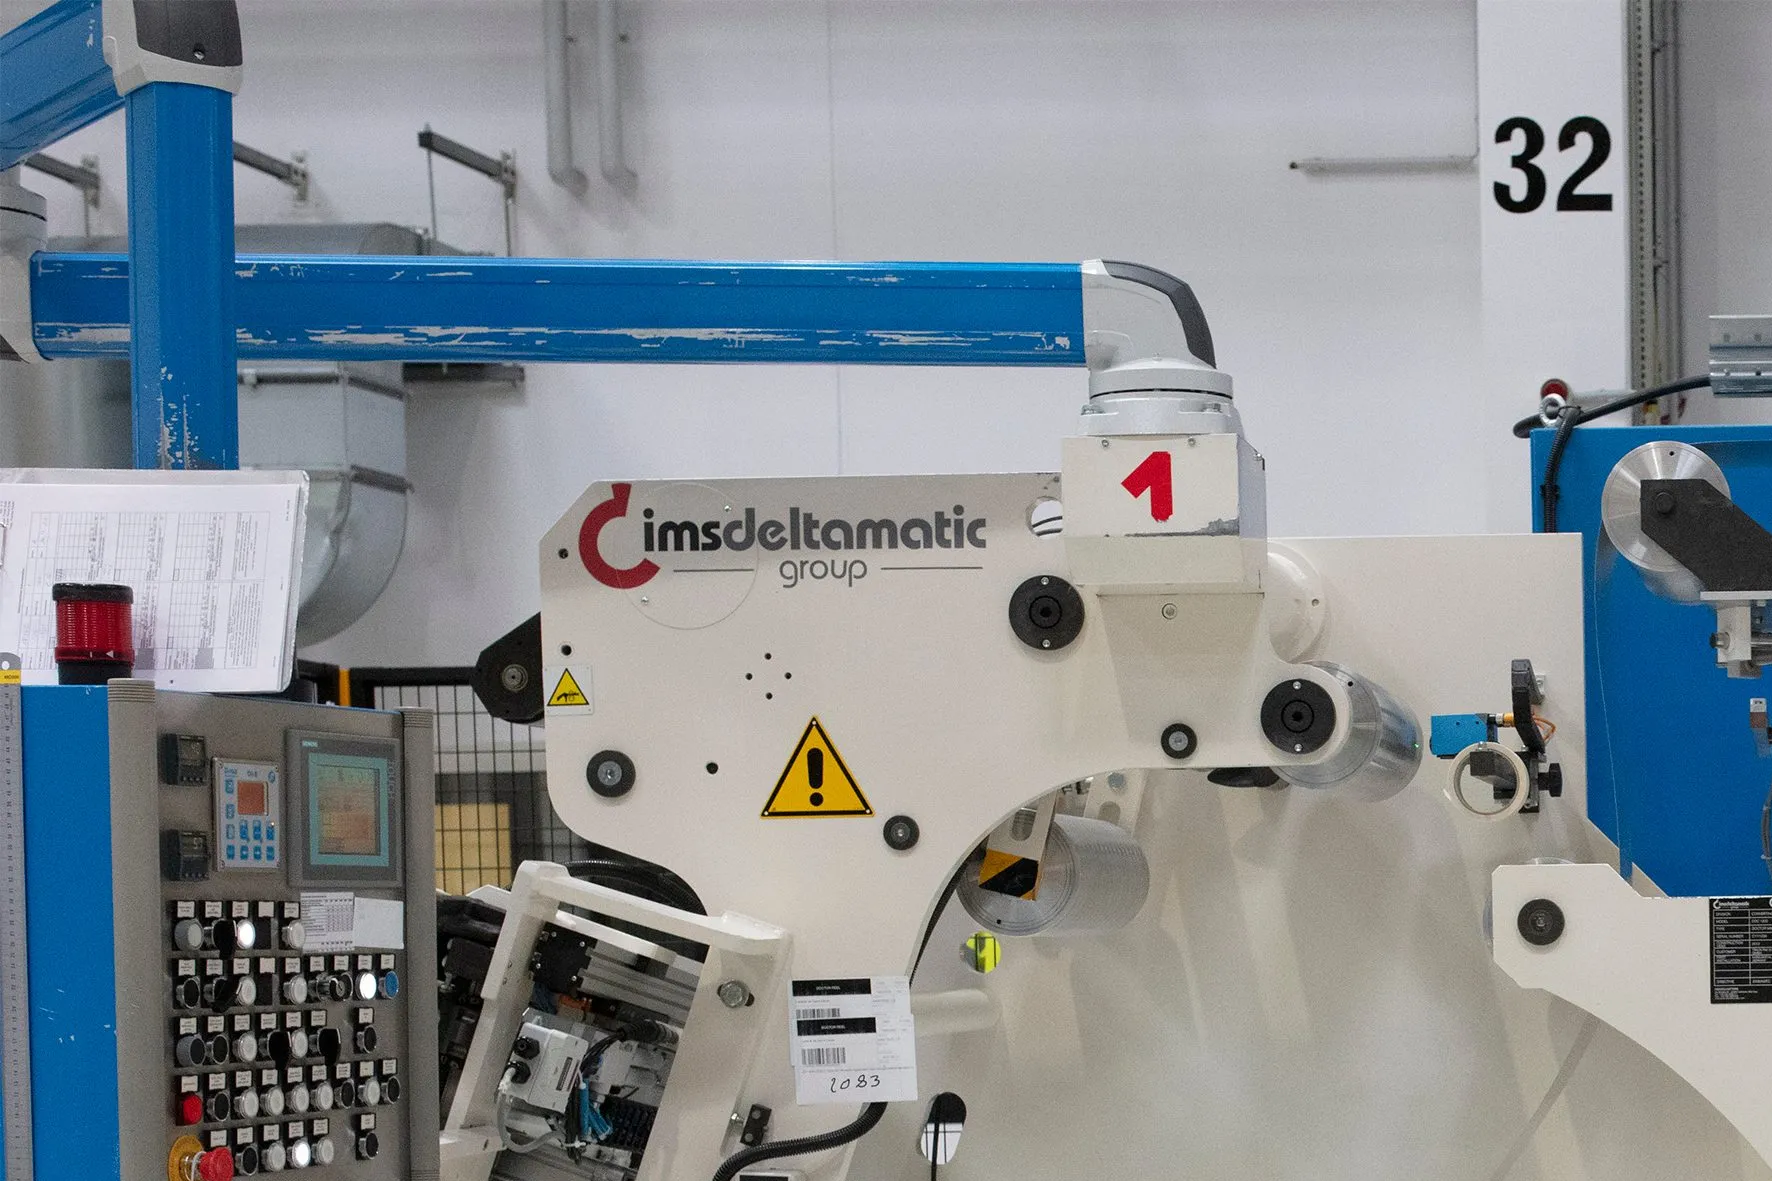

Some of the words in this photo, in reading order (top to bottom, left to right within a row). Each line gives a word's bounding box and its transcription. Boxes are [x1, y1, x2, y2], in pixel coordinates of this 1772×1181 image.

[1493, 116, 1613, 213] 32
[1121, 451, 1174, 523] 1
[643, 504, 987, 552] imsdeltamatic
[779, 559, 867, 588] group
